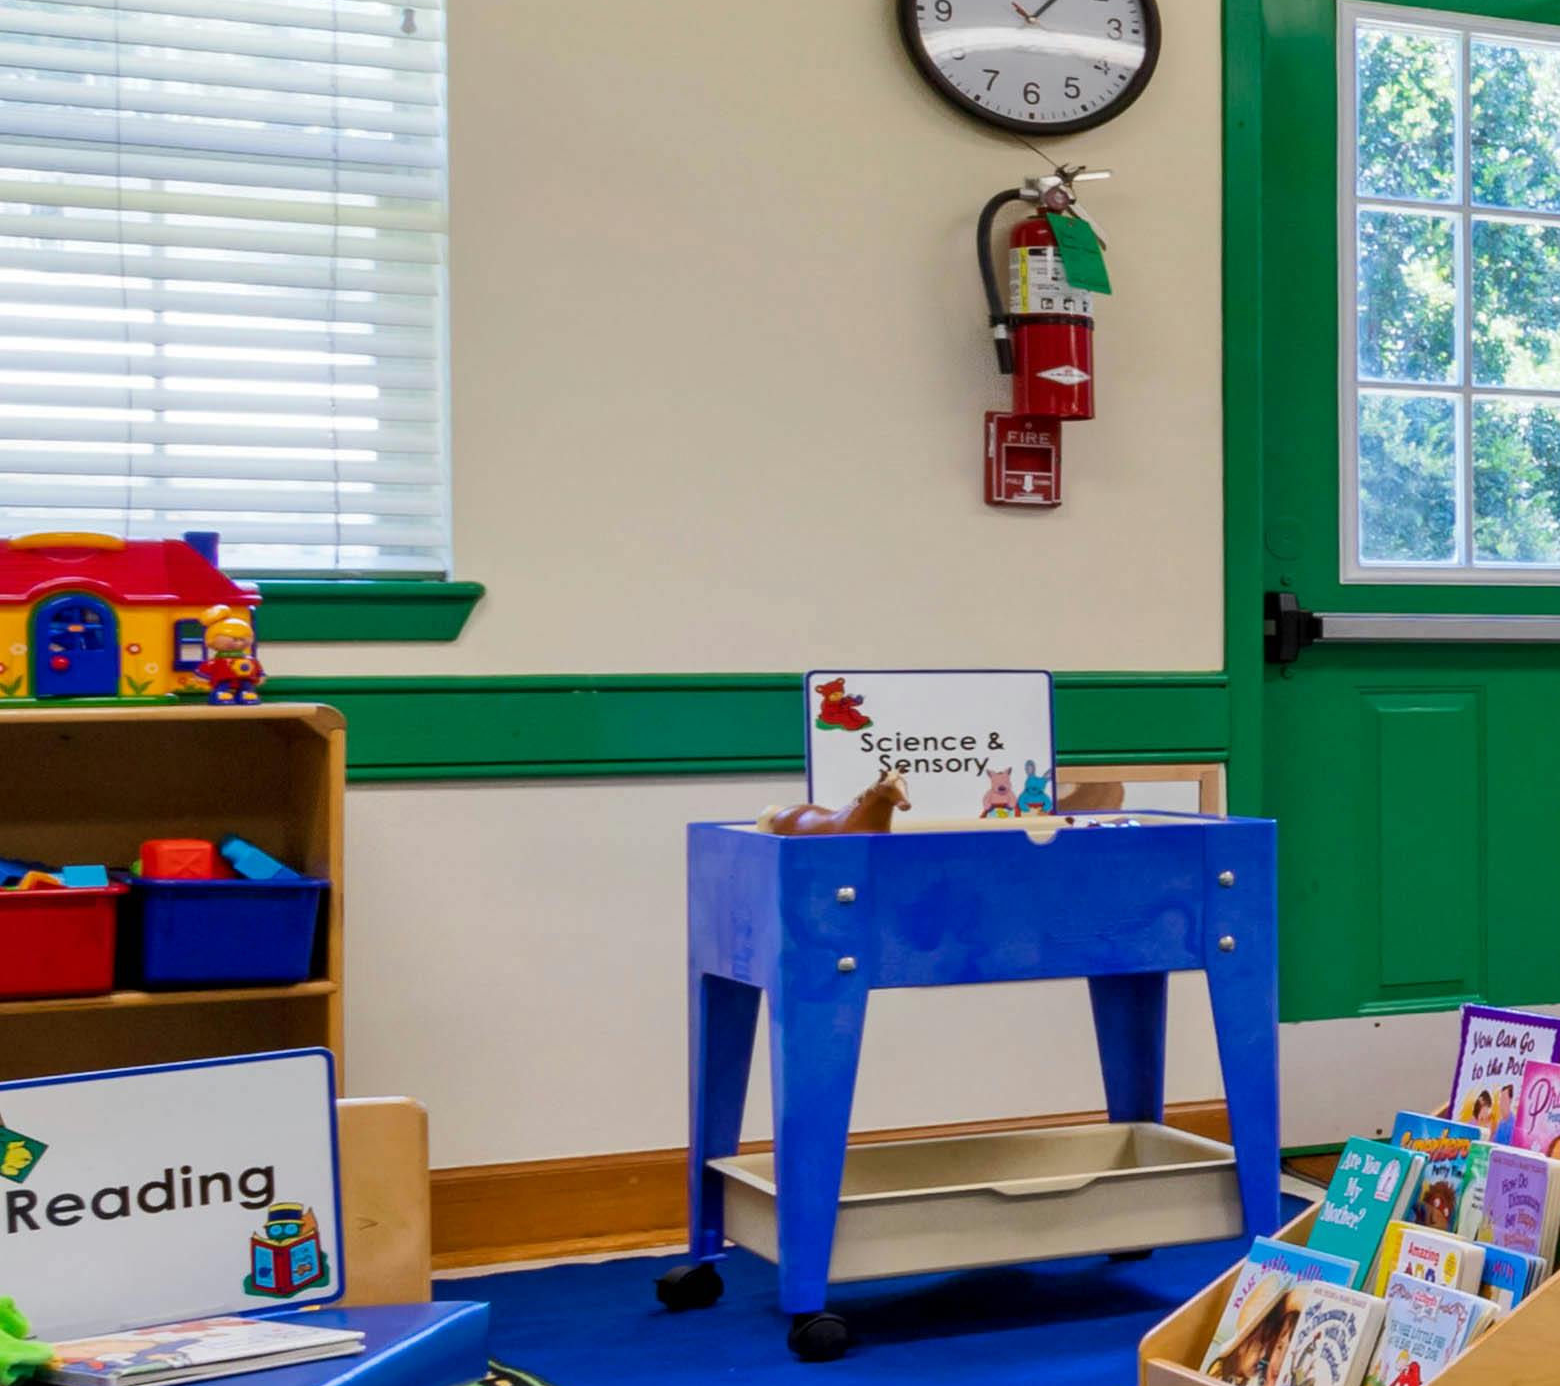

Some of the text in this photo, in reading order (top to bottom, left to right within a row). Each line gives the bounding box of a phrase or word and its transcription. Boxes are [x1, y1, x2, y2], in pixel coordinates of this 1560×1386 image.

[934, 0, 952, 22] 9
[1106, 18, 1123, 40] 3
[982, 69, 1000, 91] 7
[1063, 77, 1080, 99] 5
[1023, 82, 1041, 105] 6
[1007, 431, 1050, 446] FIRE
[860, 732, 1005, 753] Science &
[878, 754, 990, 778] Sensory
[1471, 1028, 1536, 1056] You Can Go
[1471, 1056, 1527, 1081] to the Pot
[1340, 1150, 1382, 1176] Are You
[5, 1164, 276, 1233] Reading
[1344, 1176, 1364, 1205] My
[1320, 1200, 1367, 1231] Mother?
[1408, 1241, 1441, 1267] Amazing
